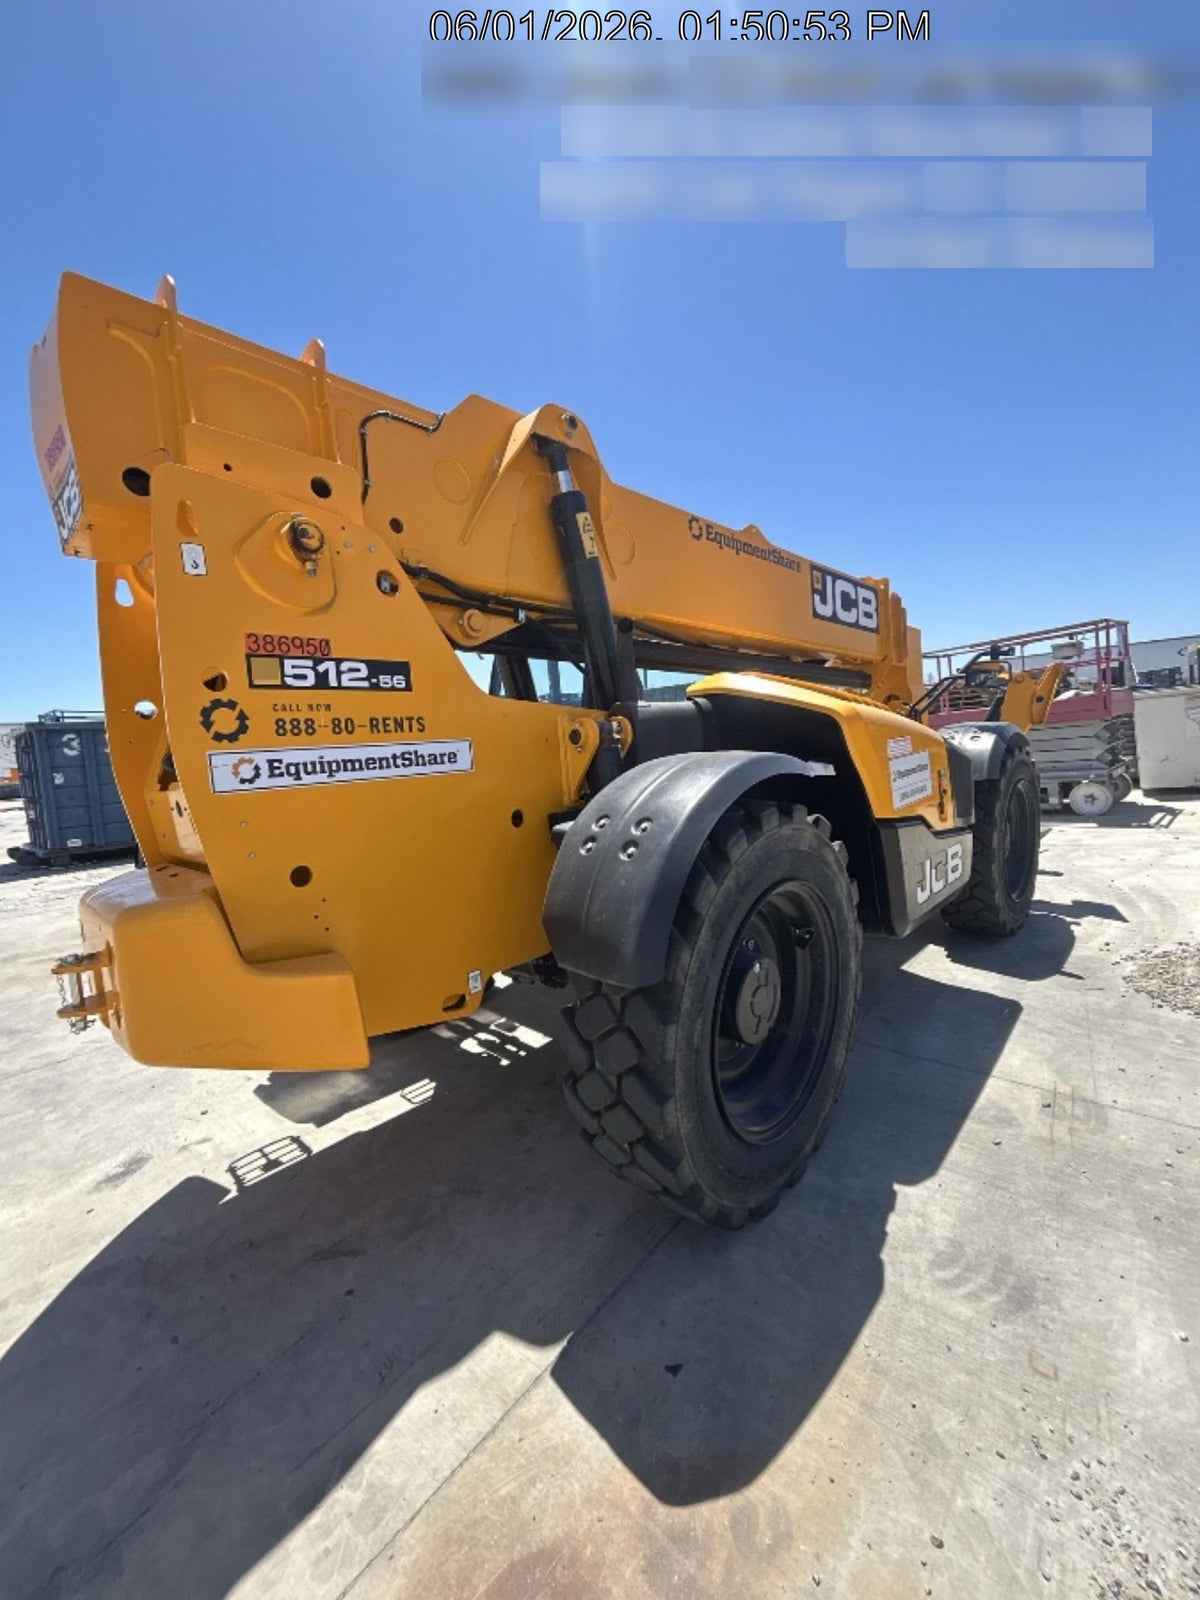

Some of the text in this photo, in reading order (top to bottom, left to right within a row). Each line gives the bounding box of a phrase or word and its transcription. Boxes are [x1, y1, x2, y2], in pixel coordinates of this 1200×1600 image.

[706, 524, 801, 573] EquipmentShare
[814, 574, 878, 629] JCB
[246, 632, 331, 657] 386950
[283, 658, 406, 688] 512-56
[272, 703, 332, 712] CALL NOW
[274, 716, 426, 736] 888-80-RENTS
[266, 749, 458, 781] EquipmentShare
[917, 843, 963, 904] JCB
